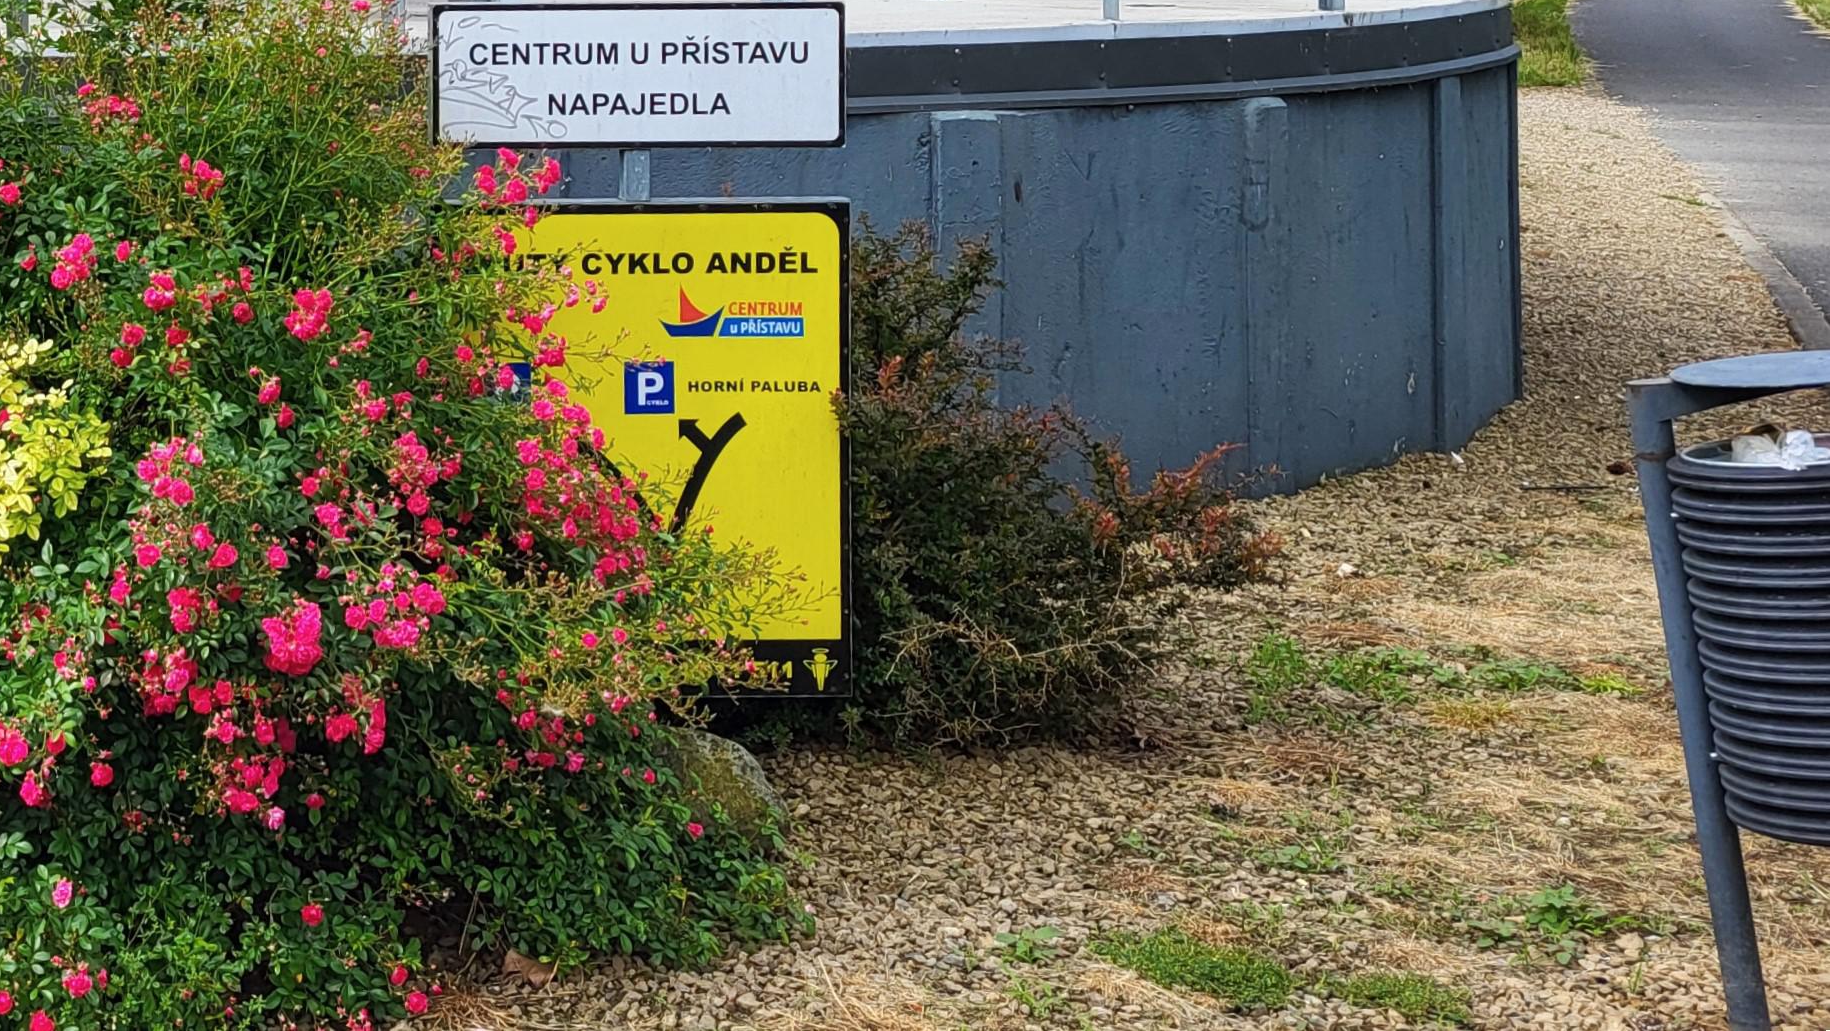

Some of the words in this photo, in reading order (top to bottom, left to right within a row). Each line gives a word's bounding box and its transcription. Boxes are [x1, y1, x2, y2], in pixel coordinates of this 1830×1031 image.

[469, 42, 619, 66] CENTRUM
[630, 41, 650, 65] U
[661, 35, 810, 65] PŘÍSTAVU
[547, 92, 731, 116] NAPAJEDLA
[581, 251, 695, 275] CYKLO
[706, 246, 818, 274] ANDĚL
[728, 302, 803, 316] CENTRUM
[729, 323, 738, 334] u
[740, 318, 801, 334] PŘÍSTAVU
[637, 371, 664, 406] P
[688, 378, 744, 392] HORNÍ
[751, 381, 821, 392] PALUBA
